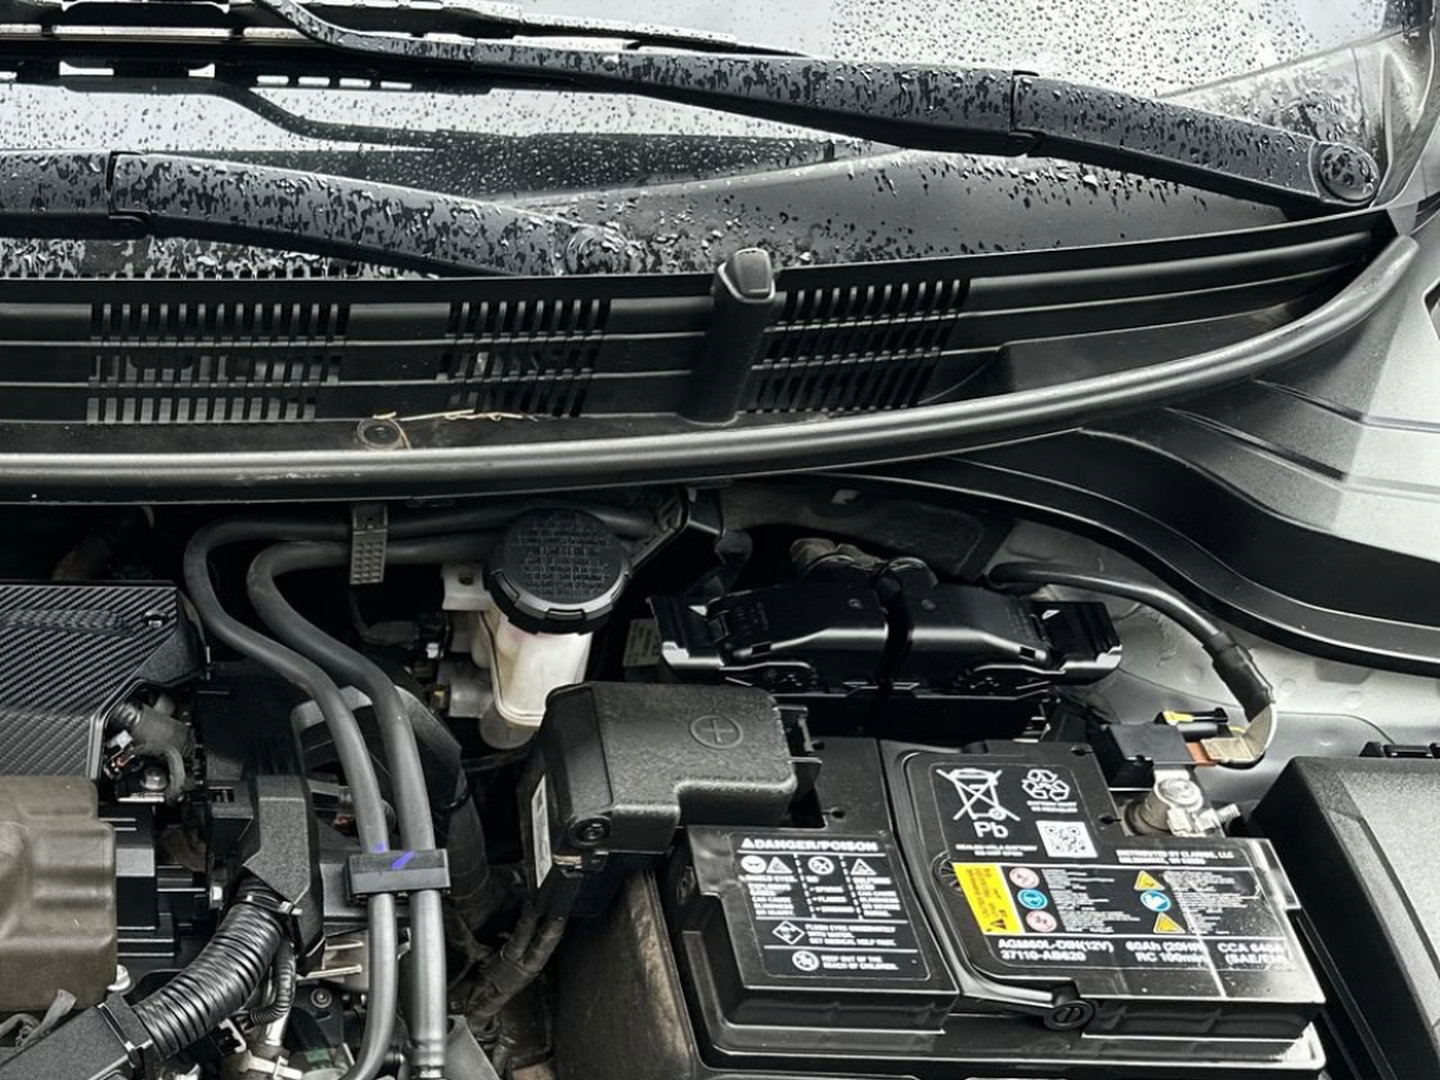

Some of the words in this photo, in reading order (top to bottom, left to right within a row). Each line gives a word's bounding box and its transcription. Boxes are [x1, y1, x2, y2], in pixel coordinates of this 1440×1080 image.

[973, 821, 1009, 838] Pb
[754, 838, 879, 852] DANGER/POISON
[1217, 942, 1248, 954] CCA
